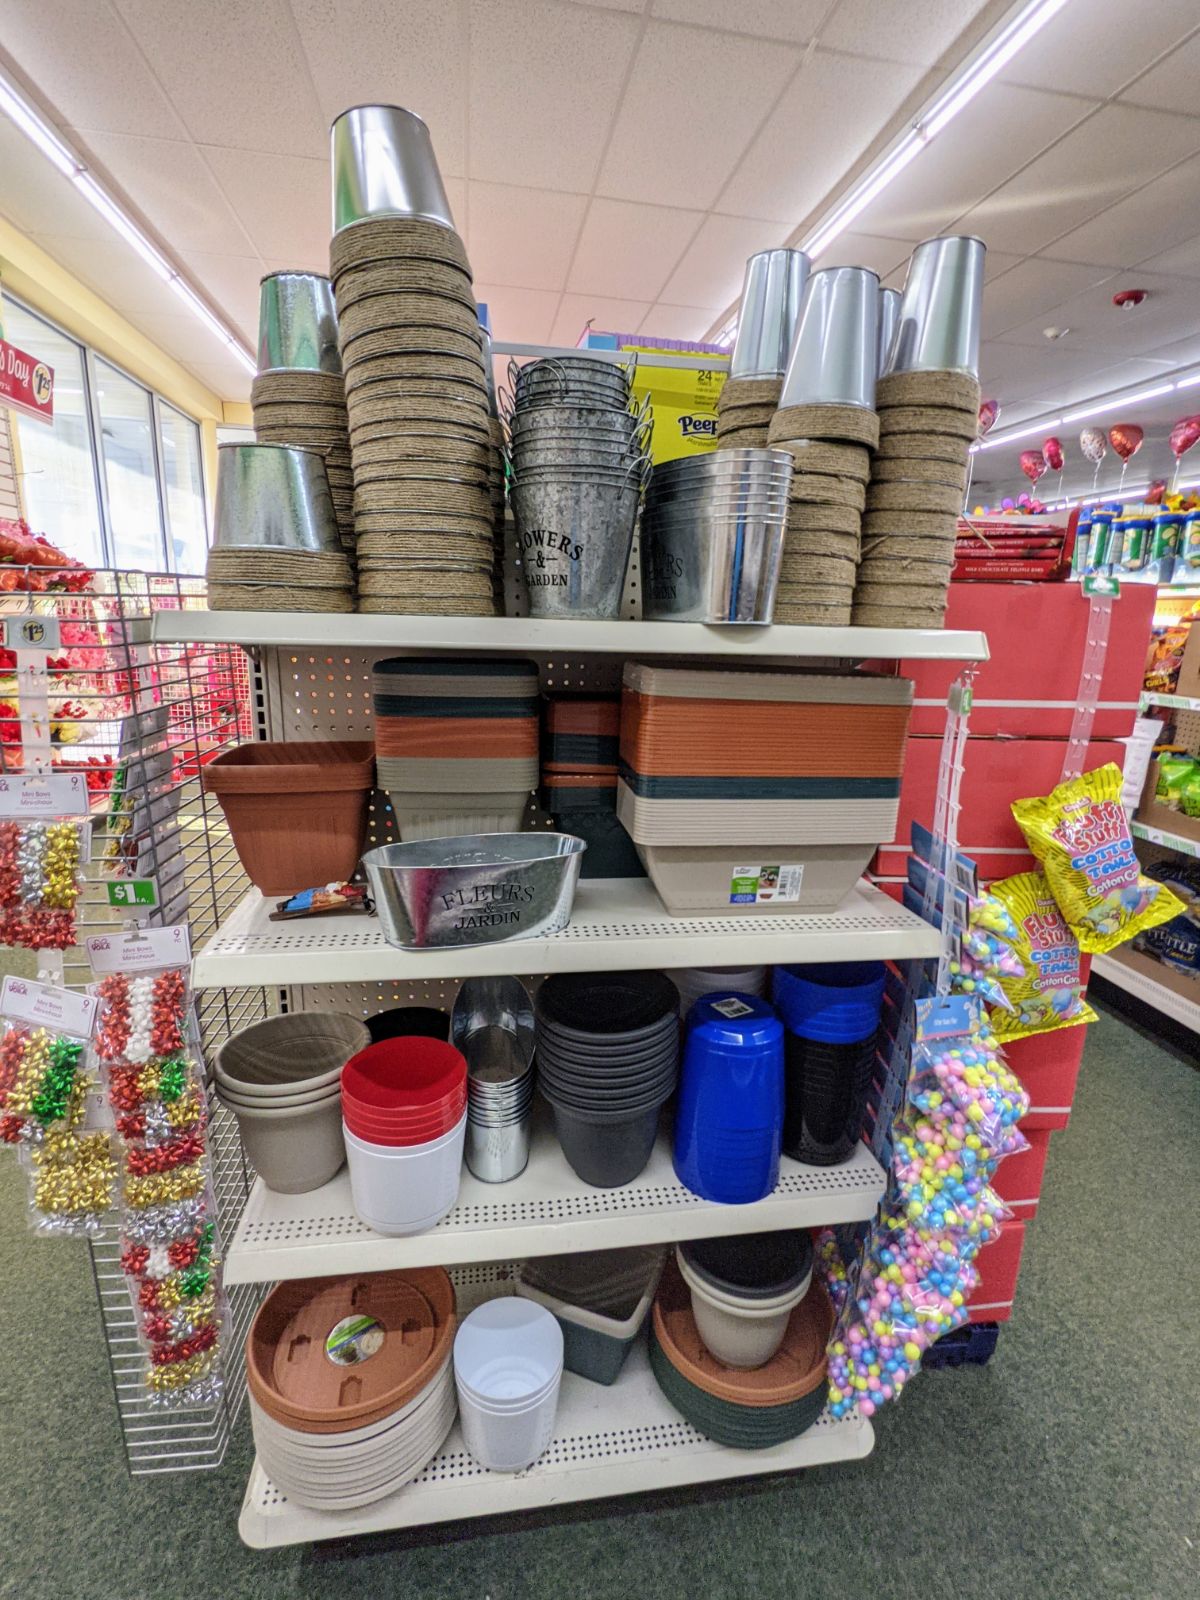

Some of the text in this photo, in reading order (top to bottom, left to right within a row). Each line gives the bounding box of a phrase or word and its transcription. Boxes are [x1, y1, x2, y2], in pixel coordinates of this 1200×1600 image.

[8, 349, 30, 387] Day
[697, 370, 712, 381] 24
[678, 415, 719, 435] Peep
[536, 550, 546, 568] &
[71, 776, 79, 786] 9
[1074, 819, 1120, 853] Stuff
[1071, 839, 1132, 869] COTTO
[114, 883, 136, 904] $1
[1087, 875, 1125, 897] Cotton
[441, 883, 535, 911] FLEURS
[484, 902, 495, 913] &
[455, 911, 521, 930] JARDIN
[173, 929, 180, 938] 9
[83, 999, 90, 1008] 9
[96, 1095, 103, 1105] 9
